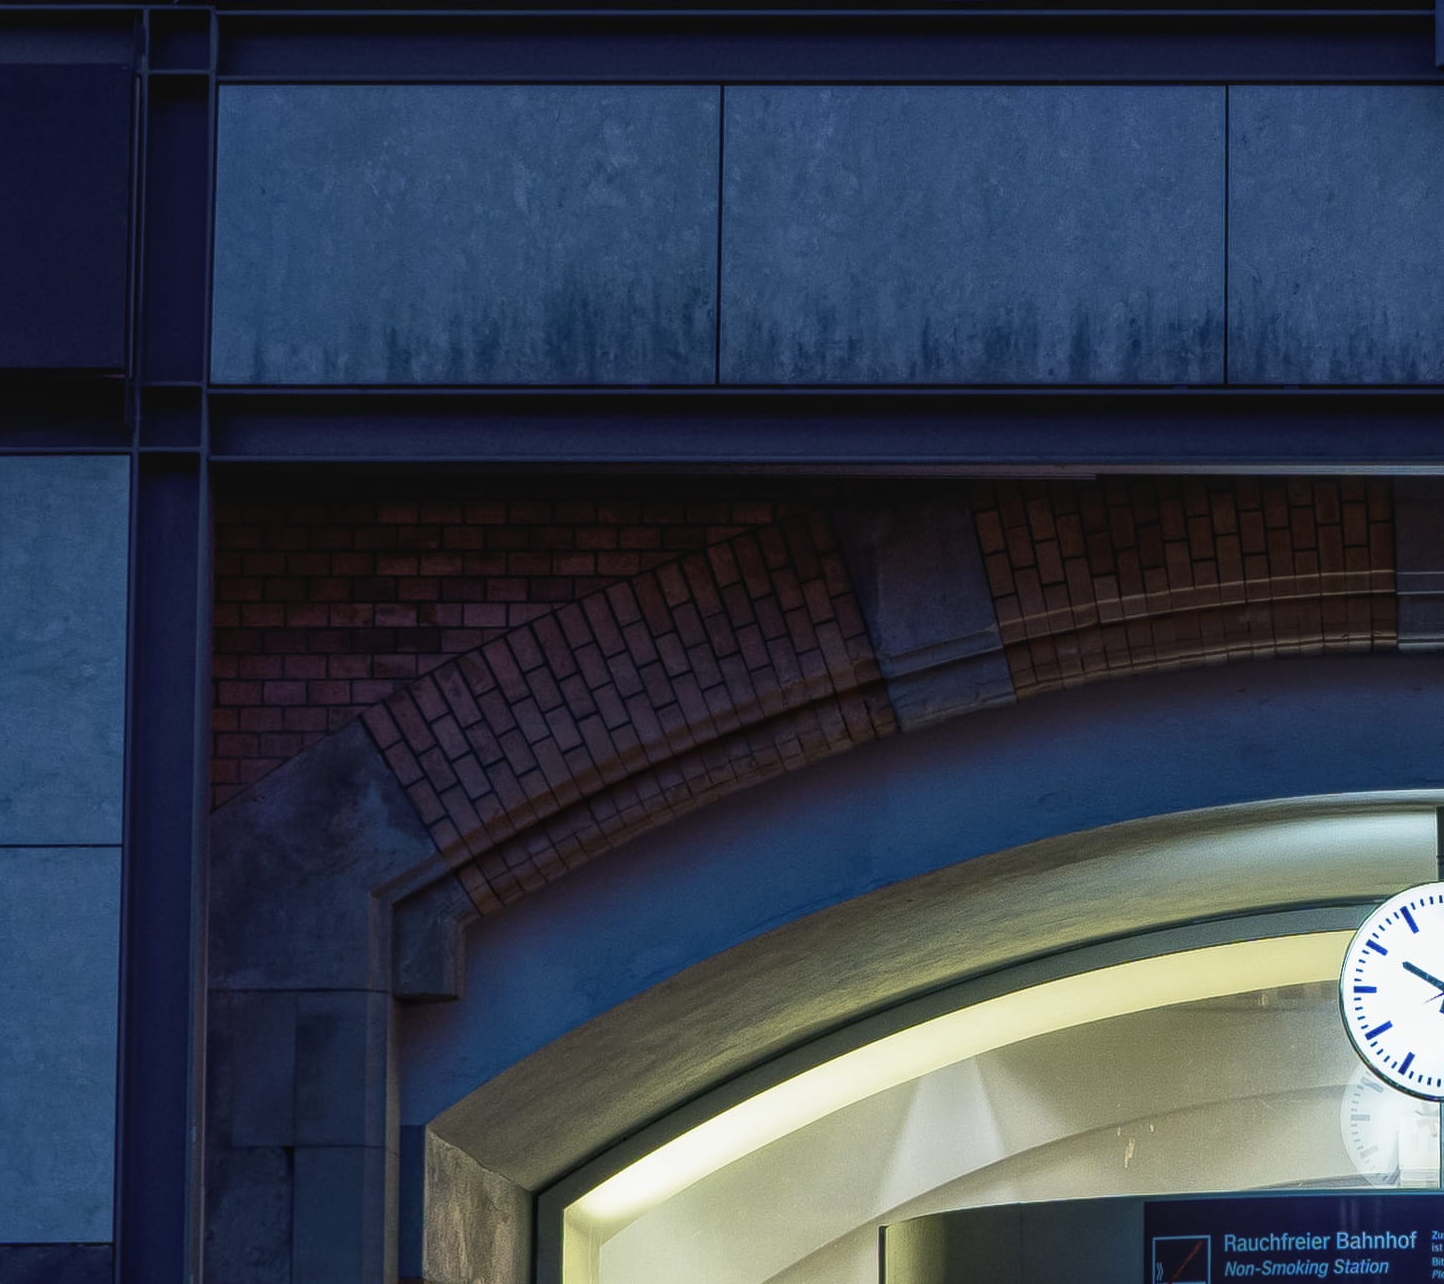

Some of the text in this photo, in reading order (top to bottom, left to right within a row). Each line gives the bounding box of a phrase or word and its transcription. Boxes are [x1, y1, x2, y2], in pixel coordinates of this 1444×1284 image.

[1224, 1231, 1418, 1252] Rauchfreier Bahnhof
[1431, 1243, 1442, 1252] ist
[1225, 1258, 1389, 1278] Non-Smoking Station
